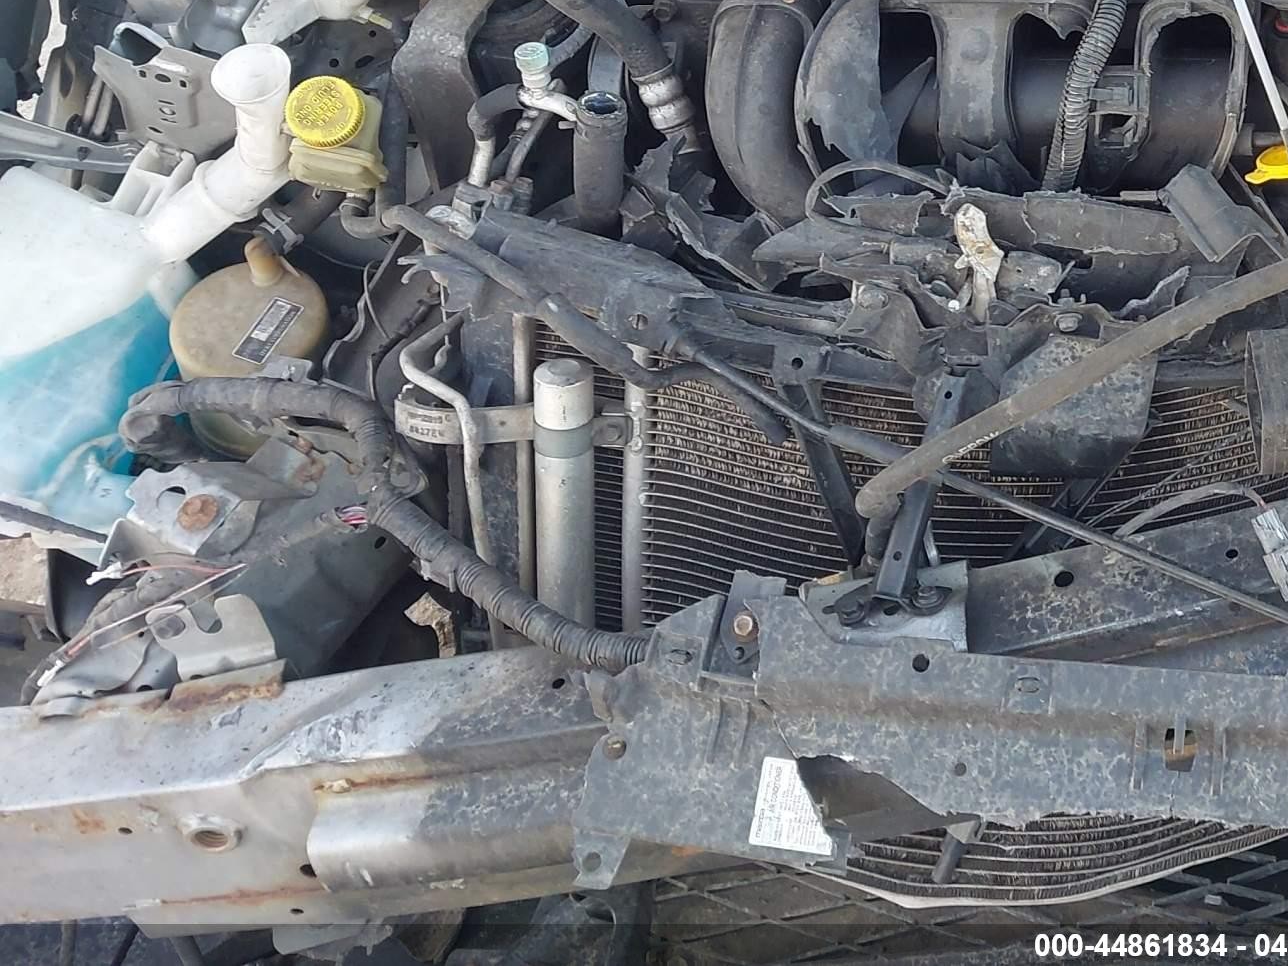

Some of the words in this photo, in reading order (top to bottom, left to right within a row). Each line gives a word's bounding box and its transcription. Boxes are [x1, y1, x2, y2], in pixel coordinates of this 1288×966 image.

[311, 81, 336, 103] FLUID
[295, 104, 312, 123] ONLY
[303, 90, 341, 126] STEERING
[316, 100, 344, 127] POWER
